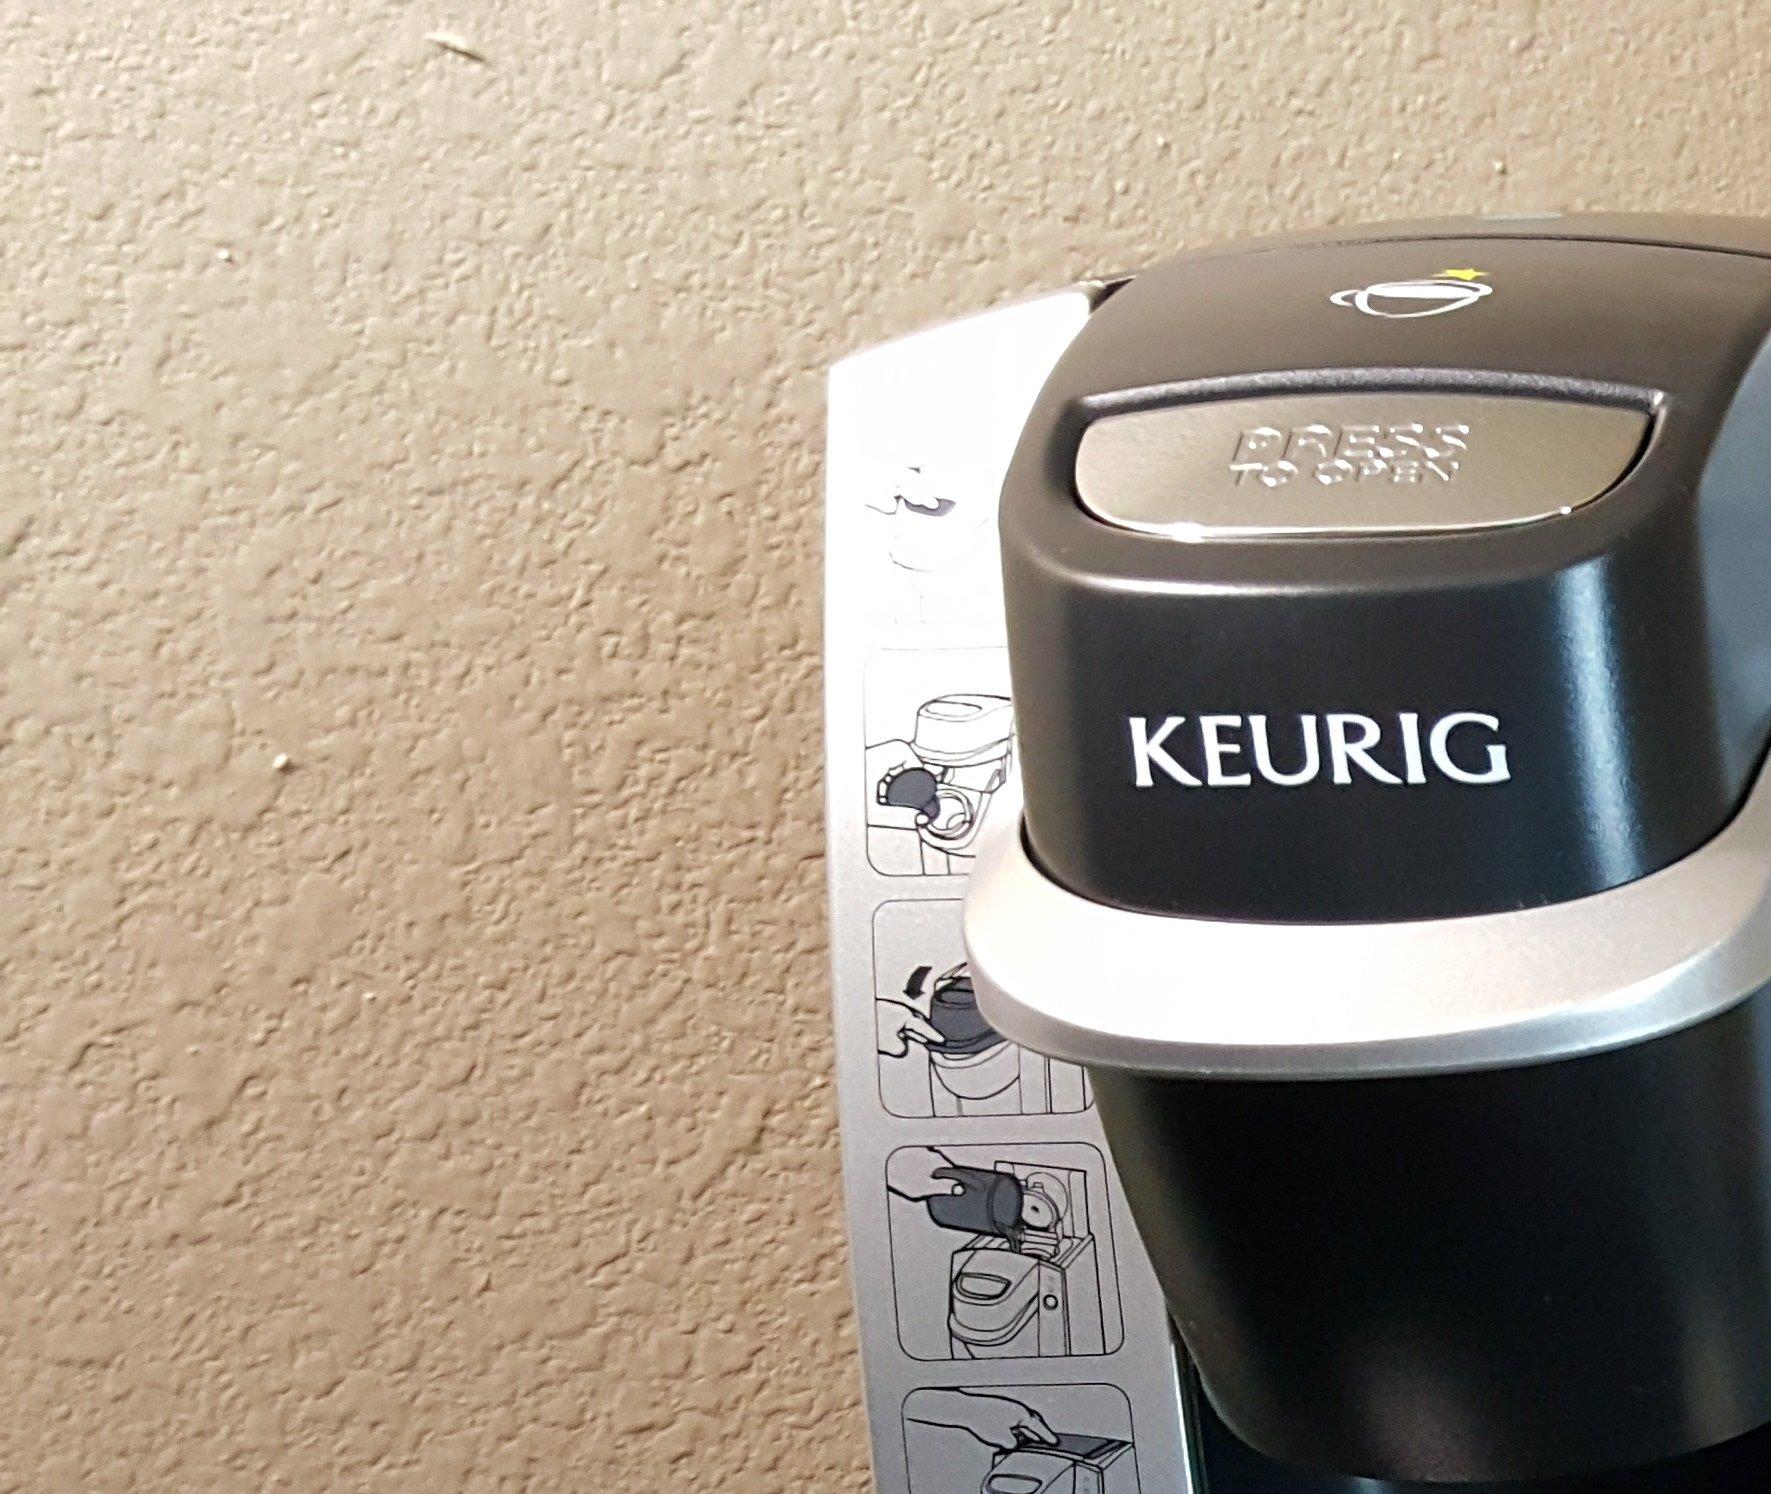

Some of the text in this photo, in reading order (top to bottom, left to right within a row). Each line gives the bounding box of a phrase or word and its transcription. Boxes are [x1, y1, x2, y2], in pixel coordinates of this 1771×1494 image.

[1232, 423, 1471, 461] PRESS
[1229, 457, 1460, 487] TO OPEN
[1128, 711, 1511, 787] KEURIG
